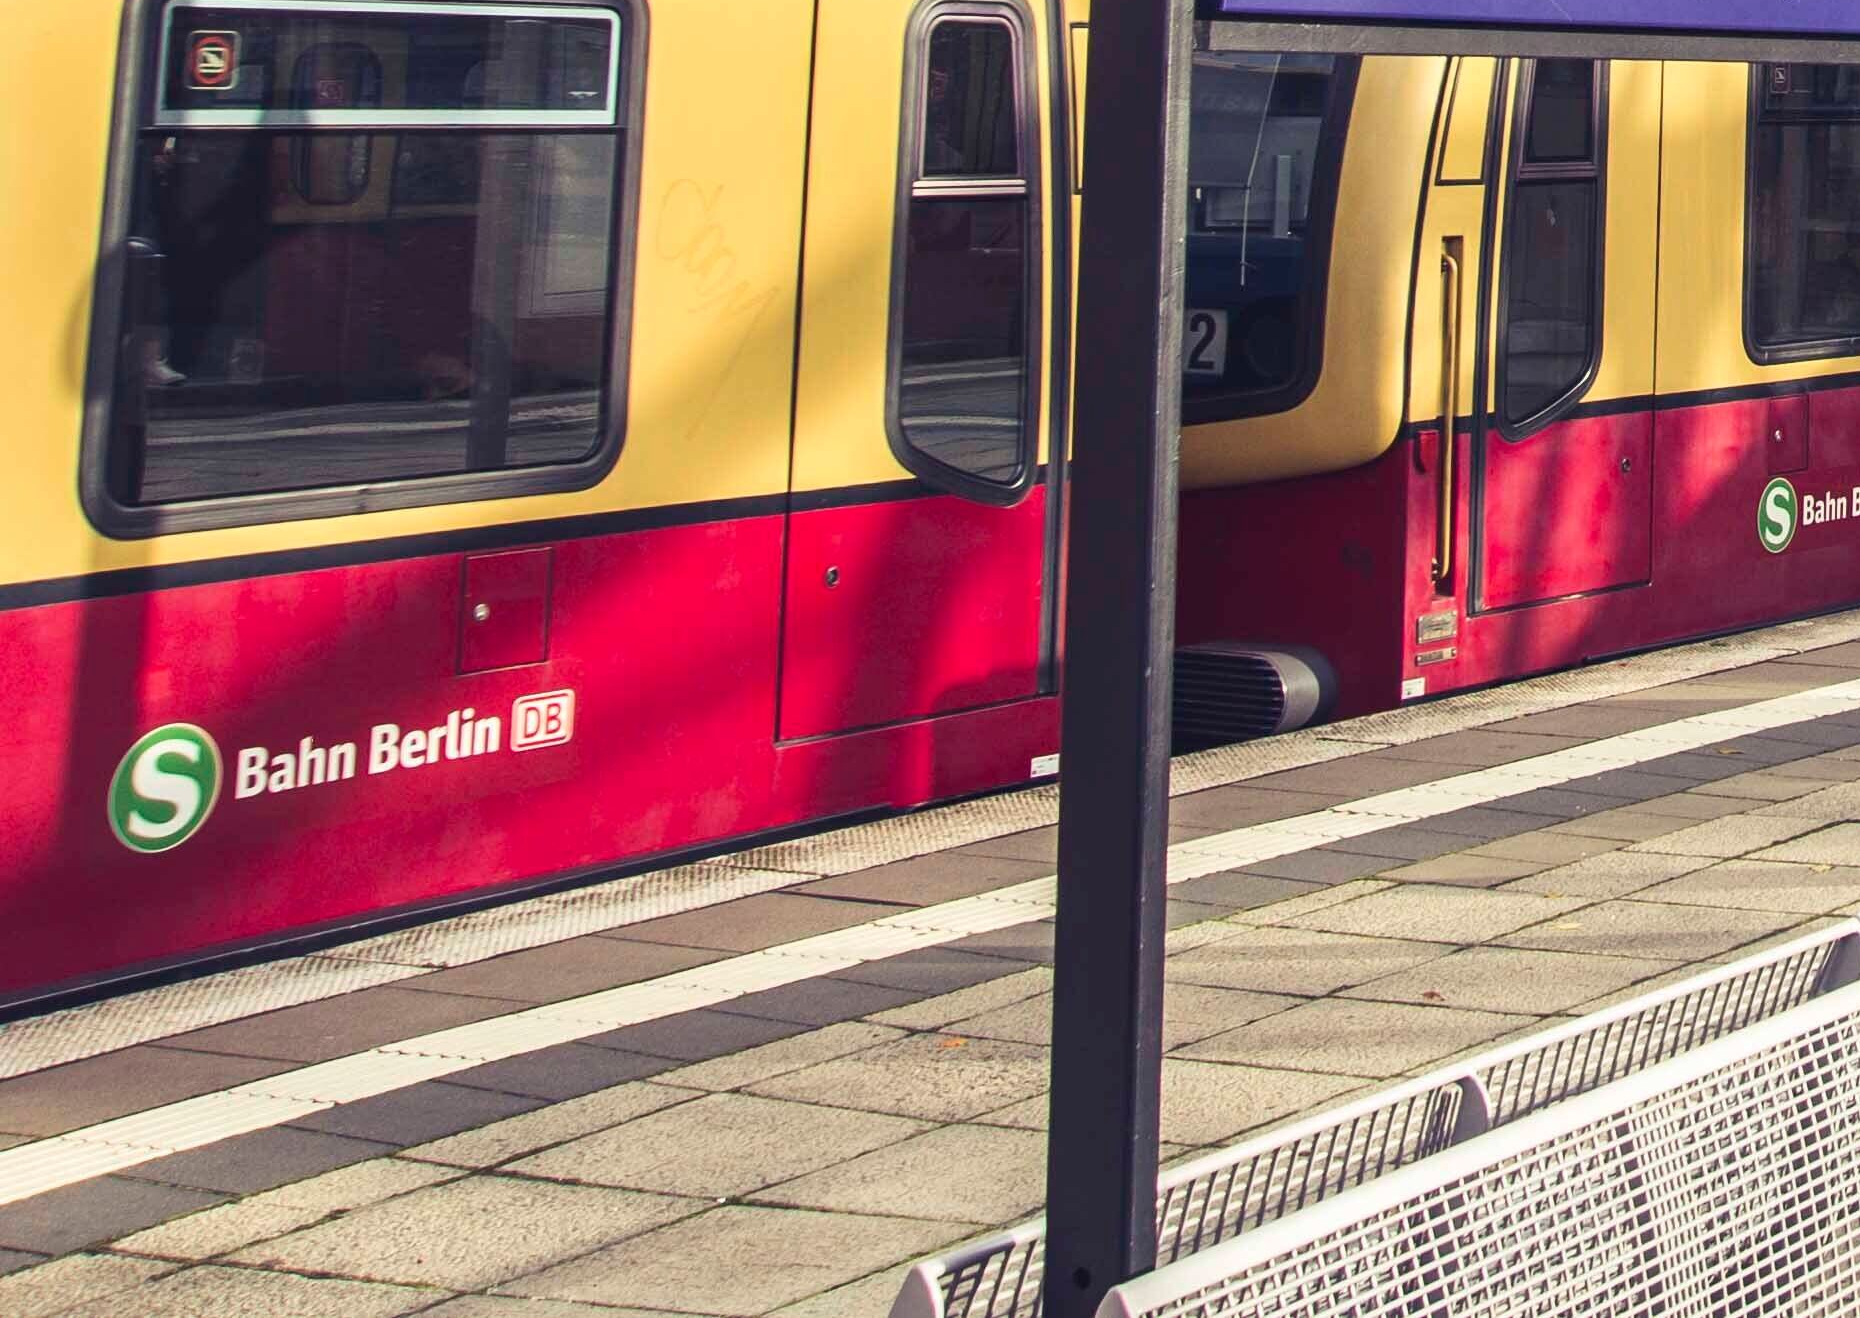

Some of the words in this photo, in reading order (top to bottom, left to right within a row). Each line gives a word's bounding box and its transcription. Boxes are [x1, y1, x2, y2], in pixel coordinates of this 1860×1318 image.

[1187, 312, 1217, 371] 2
[1802, 490, 1847, 526] Bahn
[234, 736, 358, 801] Bahn
[366, 707, 502, 775] Berlin
